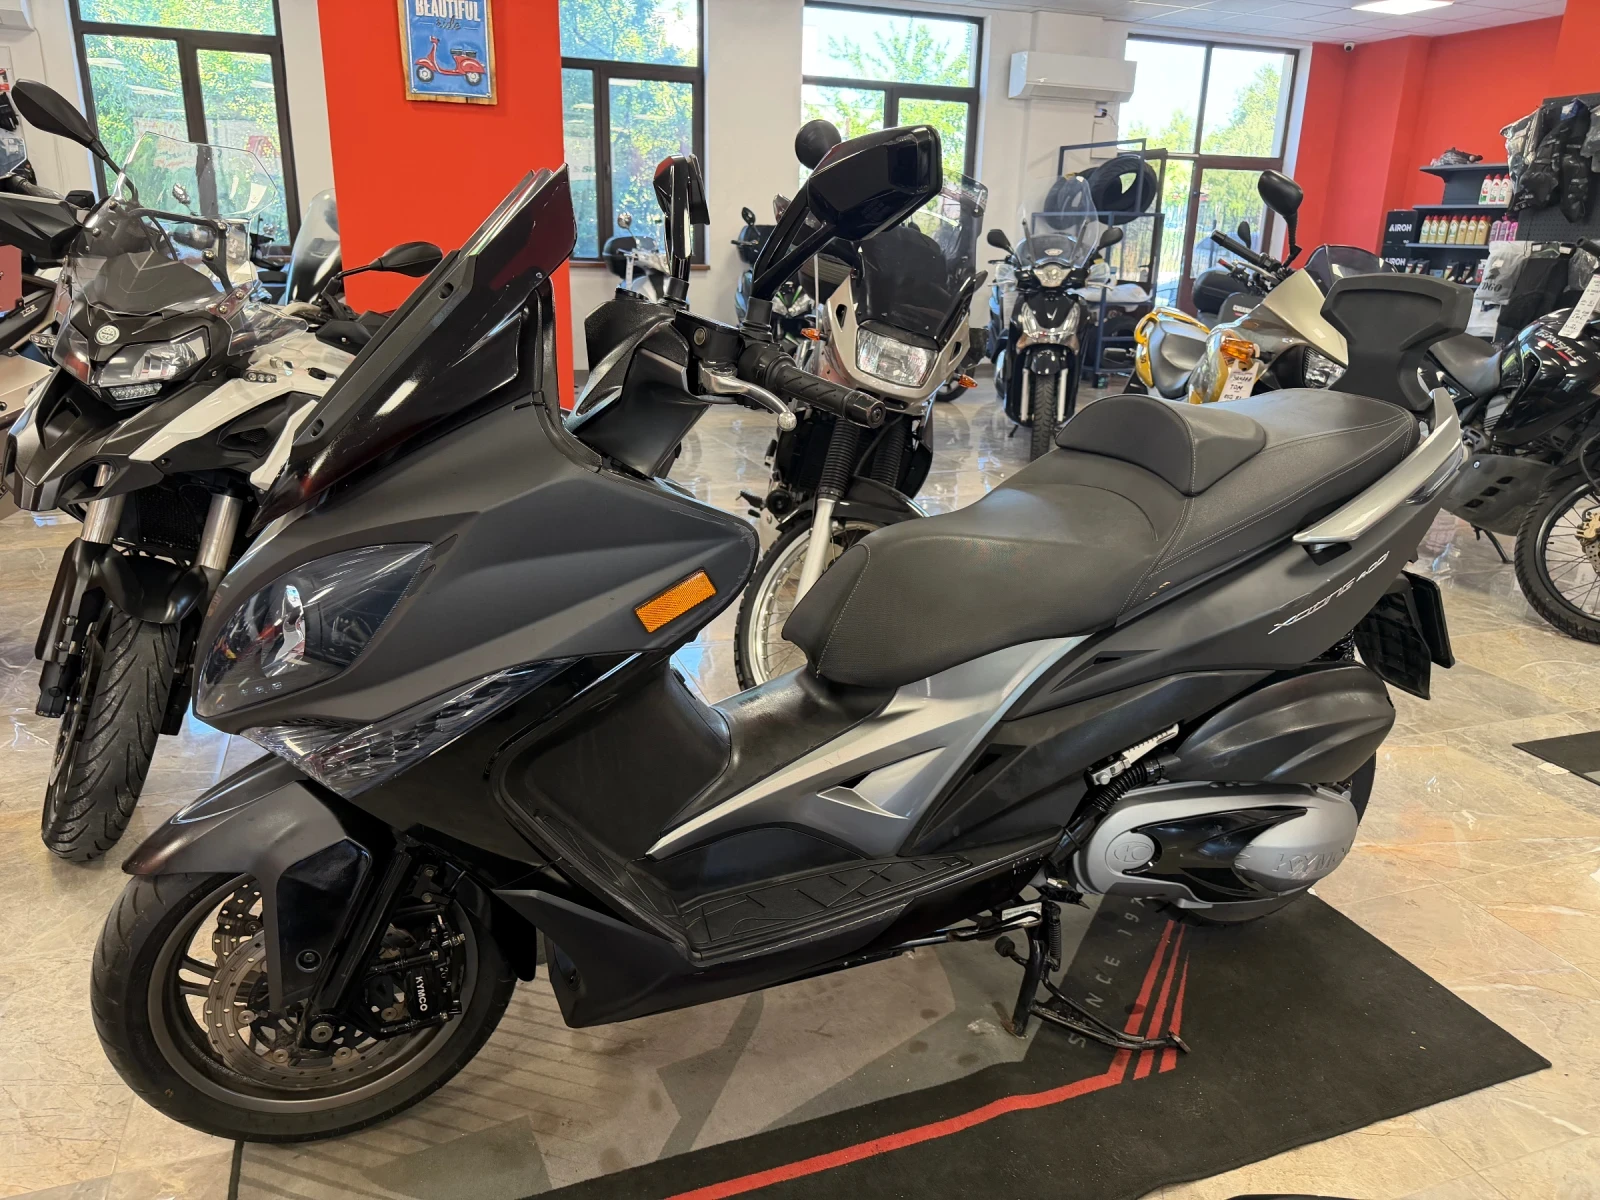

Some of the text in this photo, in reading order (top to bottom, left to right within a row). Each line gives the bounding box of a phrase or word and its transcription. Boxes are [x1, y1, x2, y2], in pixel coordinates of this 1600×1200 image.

[415, 0, 481, 21] BEAUTIFUL
[1388, 223, 1412, 232] AIROH
[415, 976, 428, 1011] KYMCO
[1068, 955, 1121, 1048] SNCE
